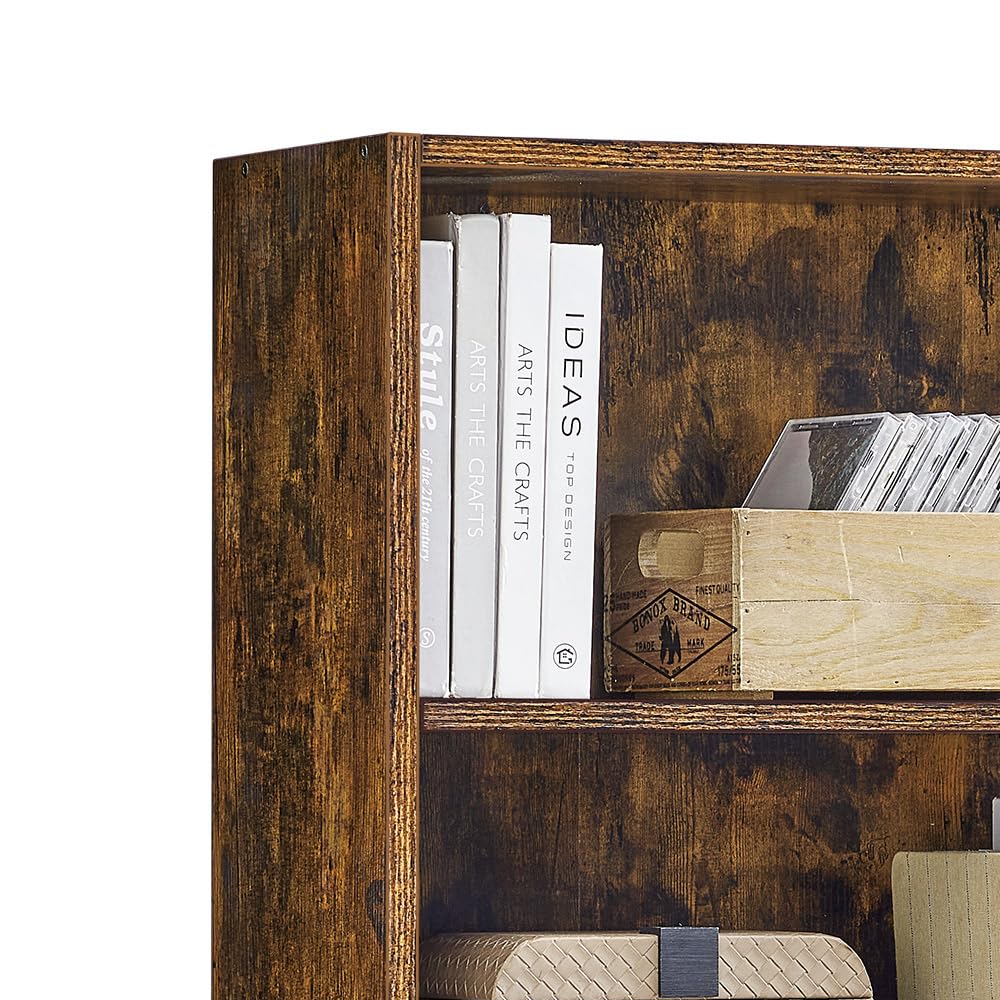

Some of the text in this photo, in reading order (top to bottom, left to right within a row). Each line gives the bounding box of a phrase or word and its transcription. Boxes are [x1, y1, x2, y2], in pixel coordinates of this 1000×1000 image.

[562, 313, 585, 437] IDEAS
[468, 340, 486, 537] ARTS THE CRAFTS
[513, 344, 533, 541] ARTS THE CRAFTS
[420, 448, 433, 561] of the 21th century
[564, 452, 575, 561] TOP DESIGN
[632, 597, 668, 633] BONOX
[673, 596, 711, 631] BRAND
[635, 638, 705, 652] TRADE MARK
[696, 585, 715, 595] FINEST
